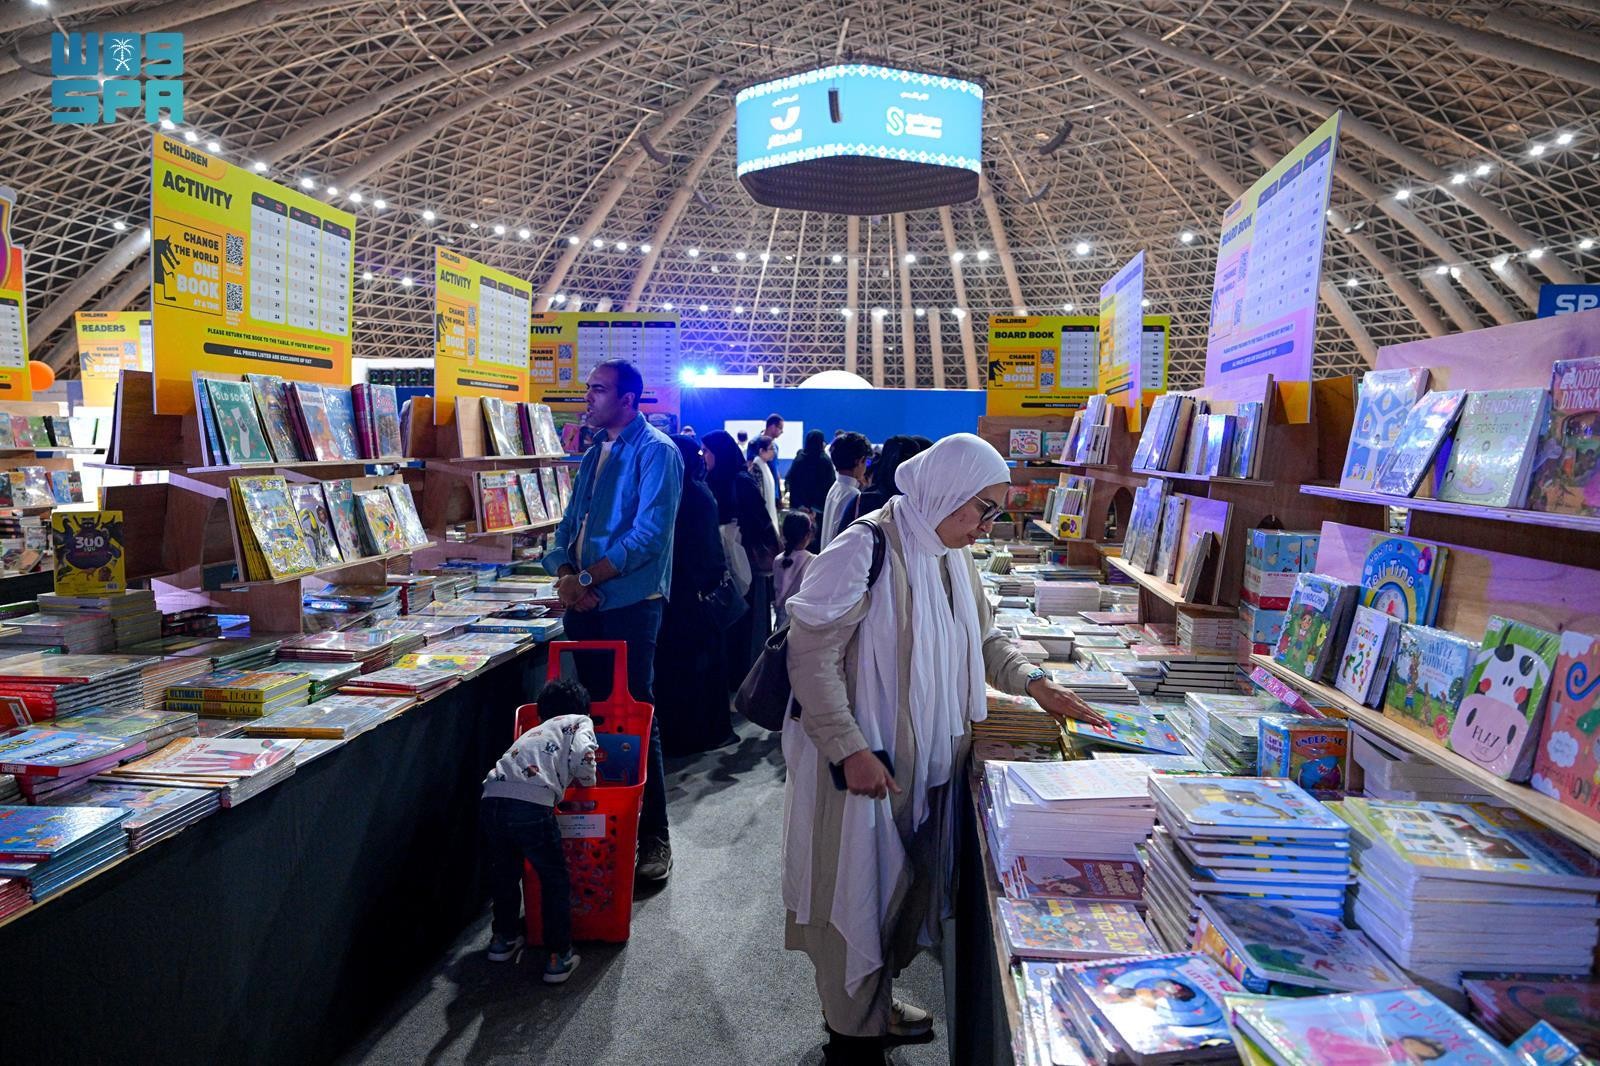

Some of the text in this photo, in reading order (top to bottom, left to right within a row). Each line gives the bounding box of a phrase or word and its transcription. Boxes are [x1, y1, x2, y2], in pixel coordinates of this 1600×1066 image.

[163, 141, 208, 168] CHILDREN
[162, 170, 233, 209] ACTIVITY
[1222, 212, 1253, 247] BOARD BOOK
[183, 232, 219, 250] CHANGE
[174, 244, 219, 264] THE WORLD
[193, 261, 219, 280] ONE
[440, 269, 472, 290] ACTIVITY
[176, 273, 219, 299] BOOK
[81, 324, 126, 333] READERS
[207, 327, 225, 336] PLEASE
[225, 330, 243, 338] RETURN
[995, 331, 1054, 339] BOARD BOOK
[233, 348, 242, 356] ALL
[1366, 559, 1414, 588] Tell Time
